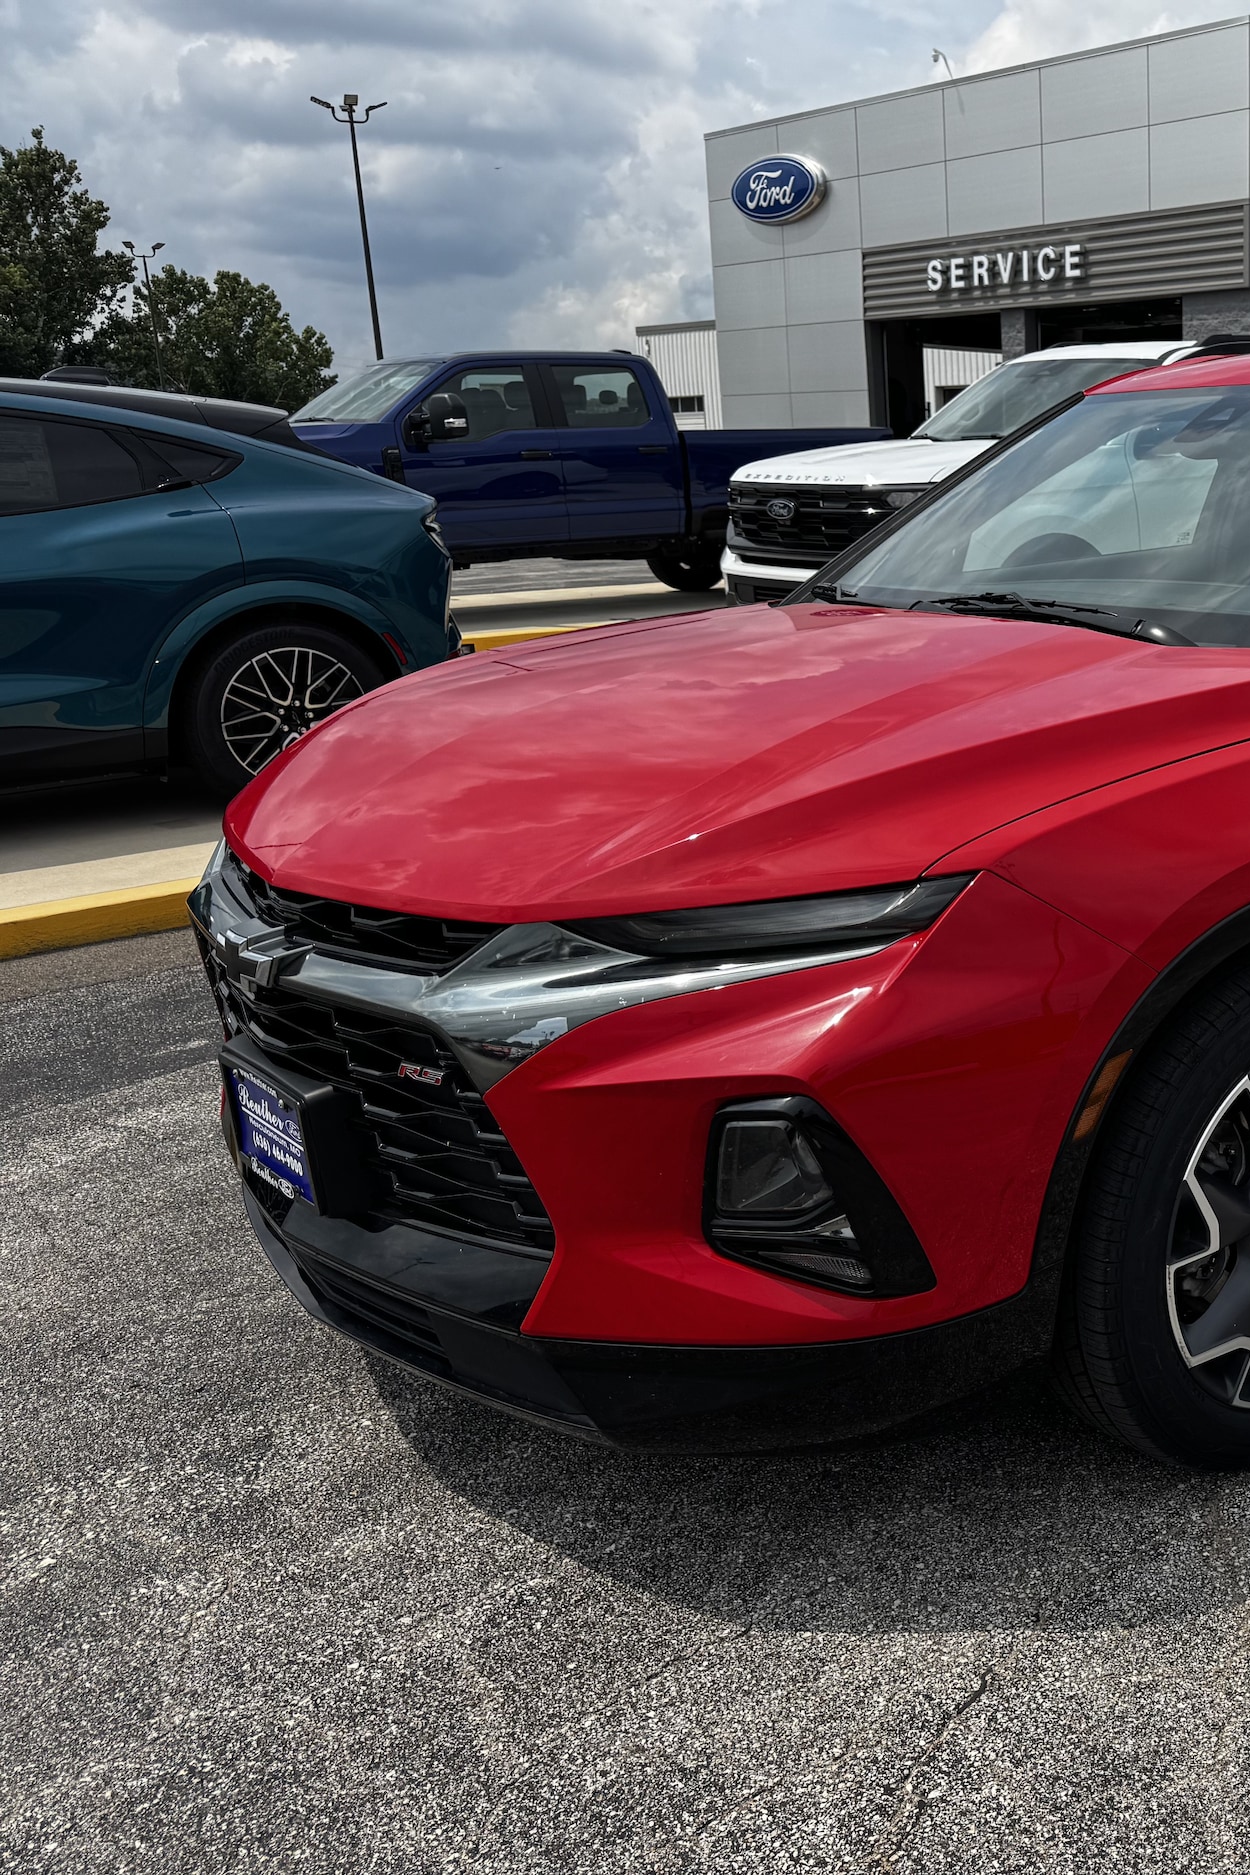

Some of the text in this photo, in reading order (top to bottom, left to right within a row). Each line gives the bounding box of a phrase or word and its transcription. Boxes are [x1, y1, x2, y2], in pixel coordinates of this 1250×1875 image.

[746, 170, 795, 209] Ford
[927, 244, 1084, 292] SERVICE
[744, 473, 847, 482] EXPEDITION
[398, 1062, 444, 1086] RS
[237, 1083, 285, 1131] Reuther
[250, 1157, 279, 1189] Reuther
[253, 1130, 304, 1177] (636) 464-9000
